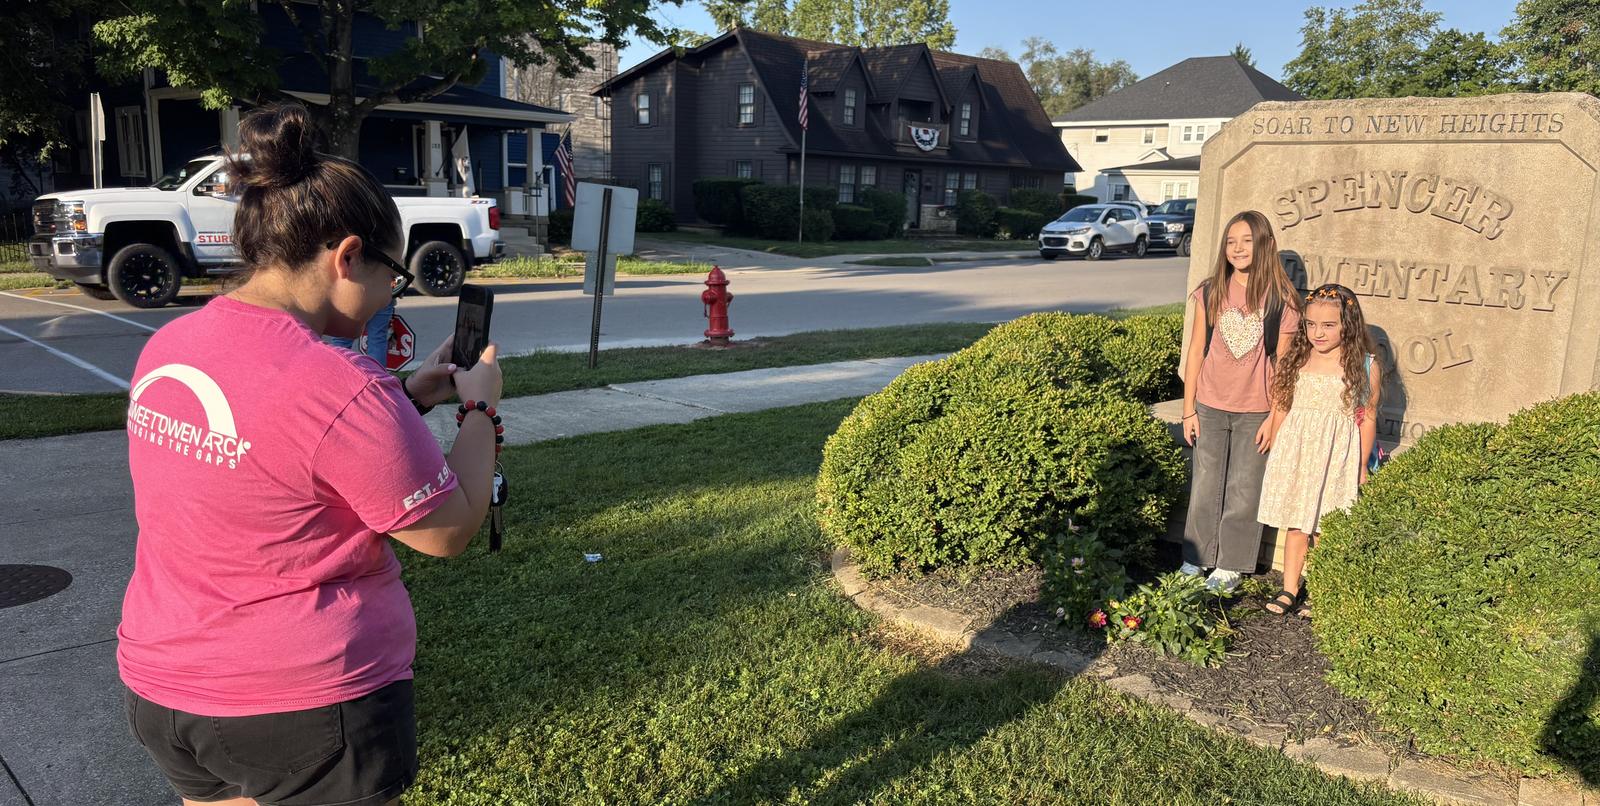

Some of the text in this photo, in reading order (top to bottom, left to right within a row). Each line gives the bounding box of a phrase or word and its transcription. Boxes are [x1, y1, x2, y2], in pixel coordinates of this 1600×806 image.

[1252, 112, 1565, 135] SOAR TO NEW HEIGHTS
[1275, 170, 1514, 240] SPENCER
[168, 438, 190, 456] THE
[196, 449, 237, 470] GAPS
[202, 431, 237, 457] ARC
[403, 482, 436, 511] EST.
